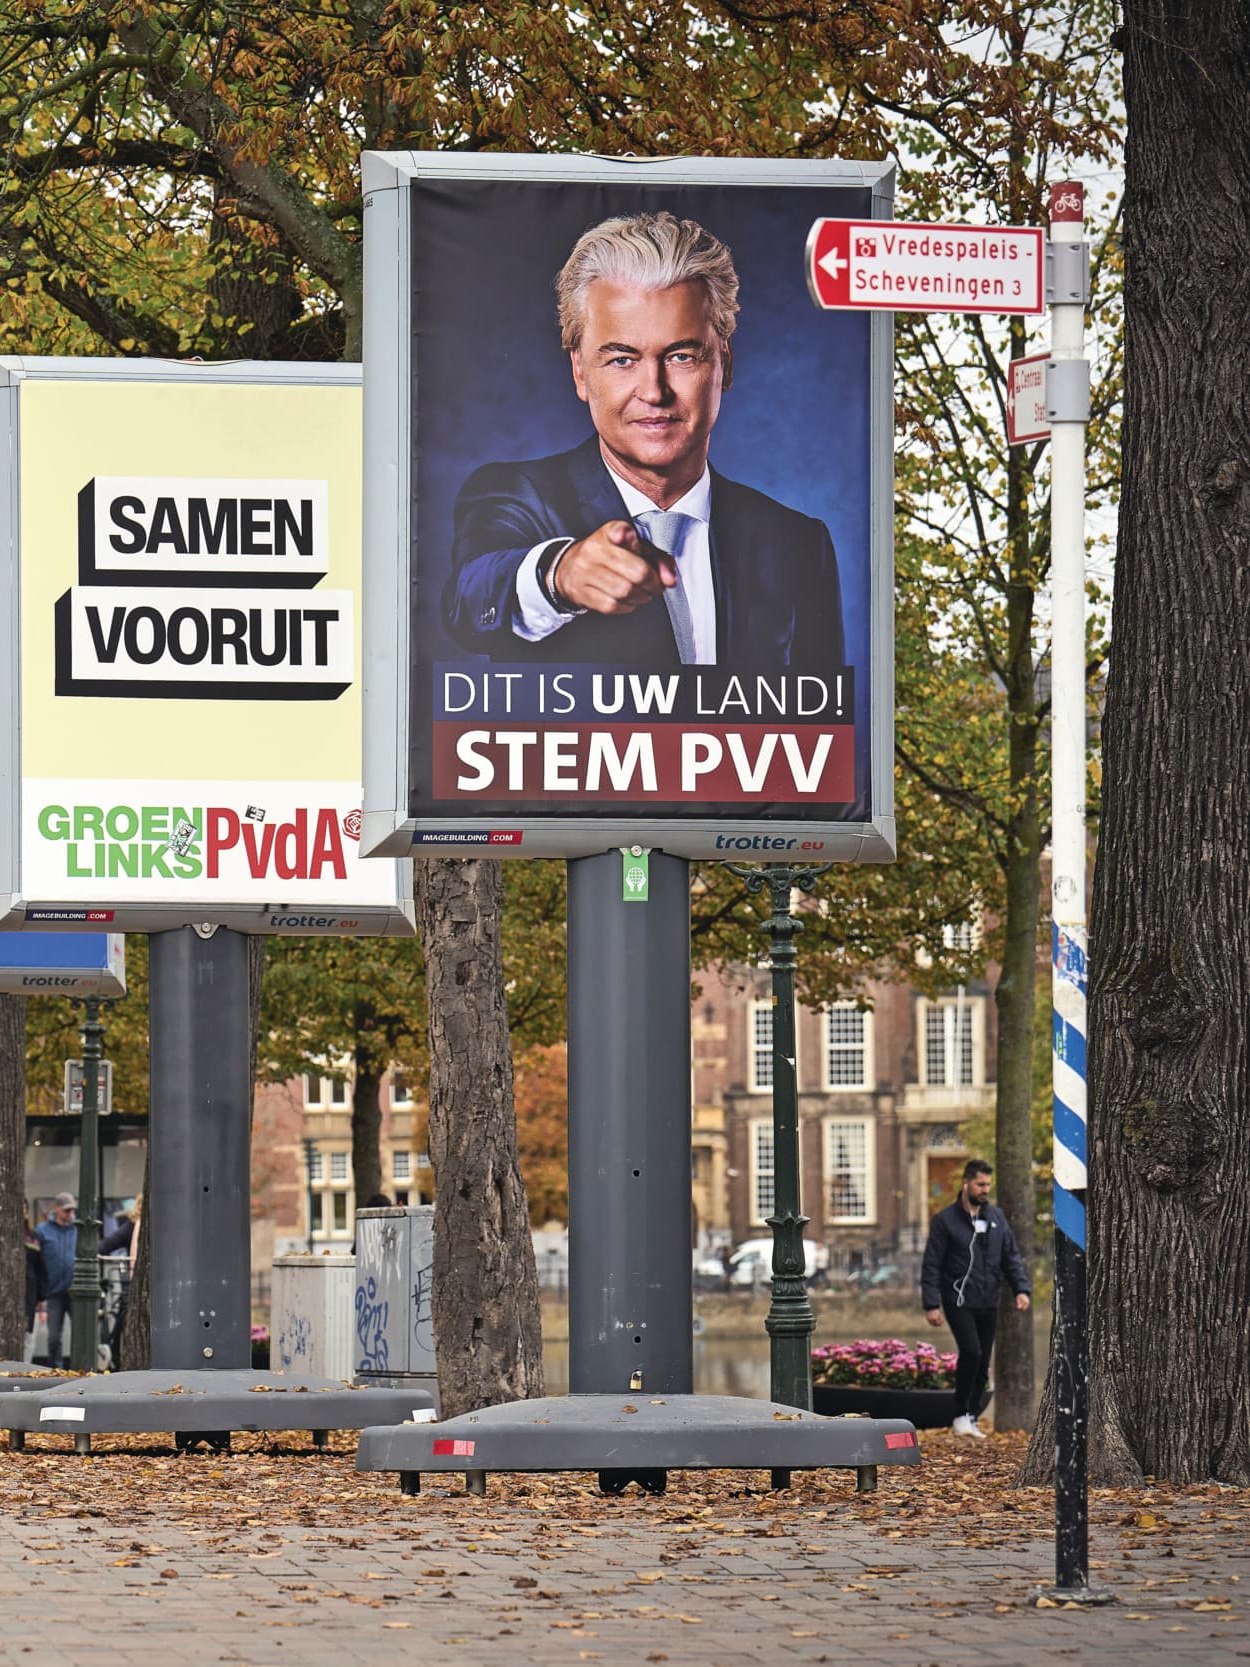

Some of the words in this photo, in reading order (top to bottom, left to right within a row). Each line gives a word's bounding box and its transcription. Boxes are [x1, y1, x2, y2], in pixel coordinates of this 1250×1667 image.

[882, 234, 1018, 262] Vredespaleis
[855, 269, 1004, 300] Scheveningen
[1012, 280, 1022, 296] 3
[108, 495, 313, 556] SAMEN
[85, 605, 339, 667] VOORUIT
[444, 672, 522, 713] DIT
[538, 673, 576, 714] IS
[592, 674, 680, 714] UW
[696, 675, 844, 716] LAND!
[455, 730, 658, 792] STEM
[681, 733, 834, 793] PVV
[38, 805, 203, 841] GROEN
[206, 807, 348, 880] PvdA
[67, 842, 203, 879] LINKS
